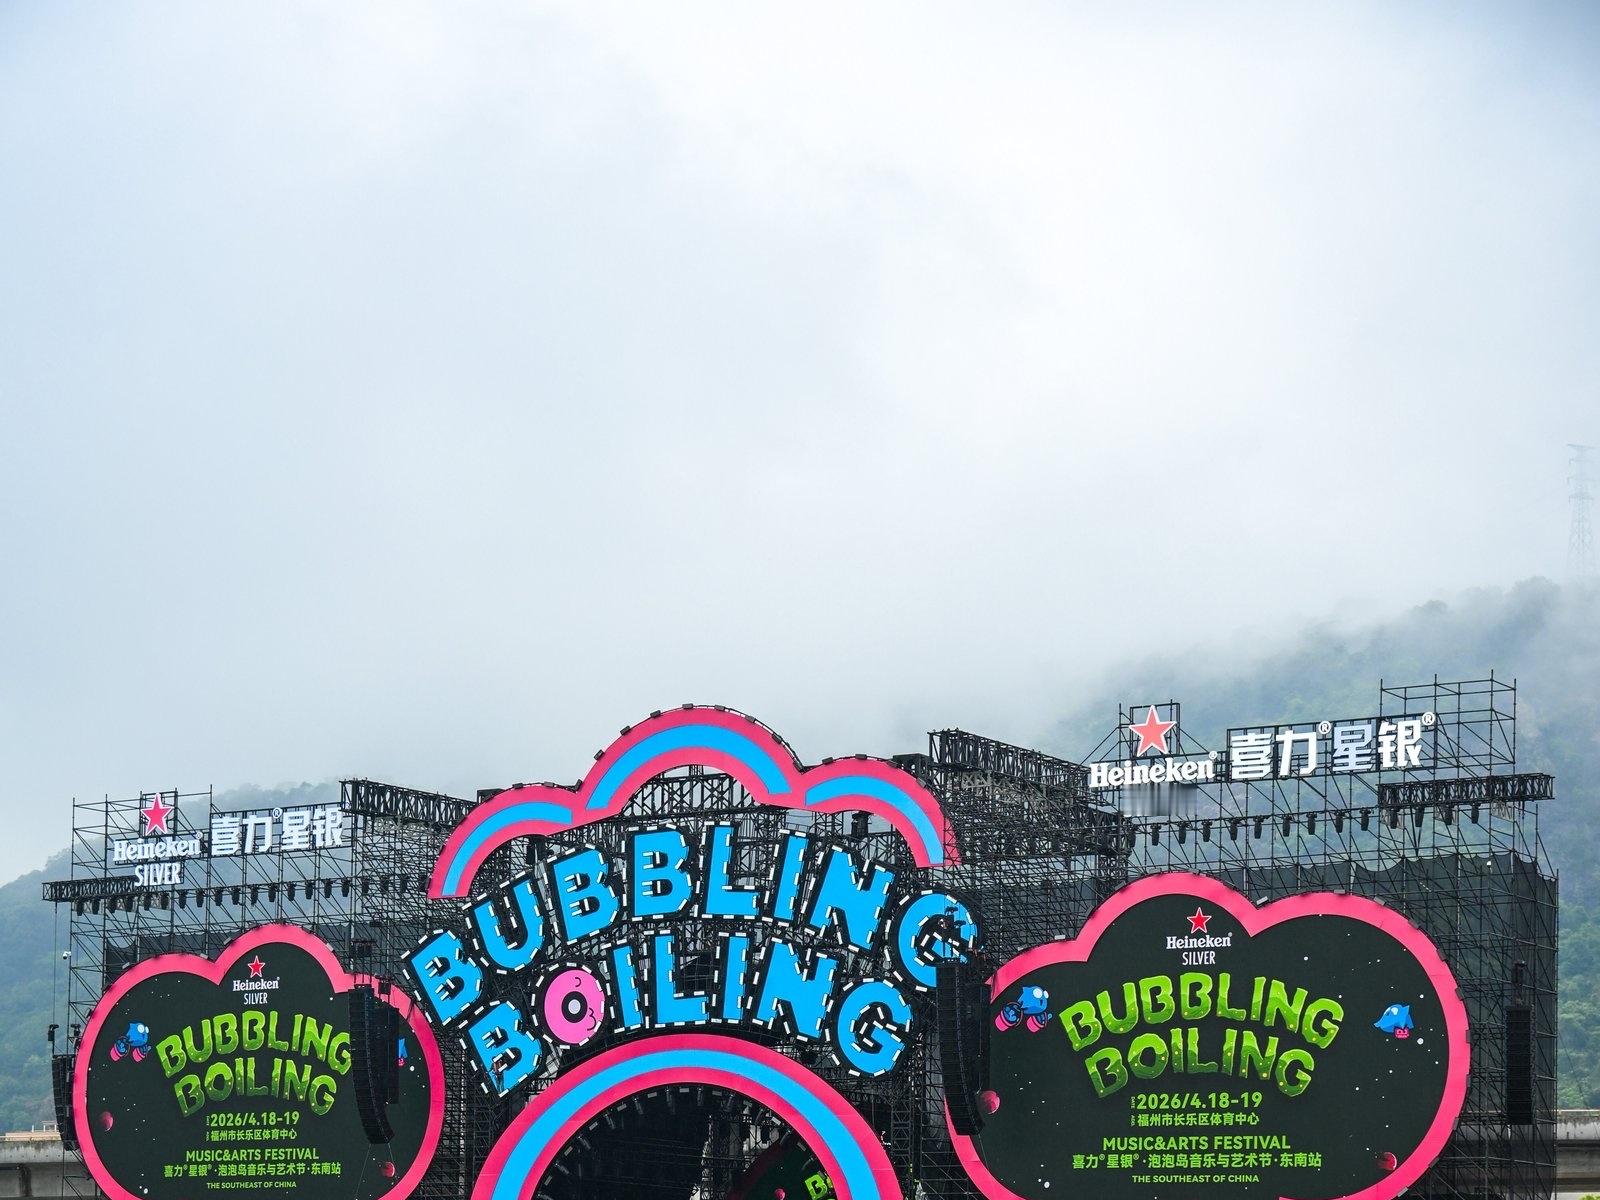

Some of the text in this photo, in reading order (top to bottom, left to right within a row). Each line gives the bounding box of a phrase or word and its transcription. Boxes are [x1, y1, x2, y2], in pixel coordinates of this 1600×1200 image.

[134, 862, 181, 887] SILVER
[410, 826, 979, 1025] BUBBLING
[1182, 950, 1216, 966] SILVER
[243, 992, 268, 1005] SILVER
[468, 931, 913, 1093] BOILING
[1059, 972, 1344, 1050] BUBBLING
[155, 1010, 352, 1078] BUBBLING
[1085, 1027, 1316, 1097] BOILING
[174, 1057, 337, 1116] BOILING
[1136, 1091, 1263, 1110] 2026/4.18-19
[210, 1110, 300, 1127] 2026/4.18-19
[1137, 1111, 1260, 1127] 福州市长乐区体育中心
[210, 1128, 298, 1142] 福州市长乐区体育中心
[1103, 1135, 1291, 1151] MUSIC&ARTS FESTIVAL
[185, 1147, 320, 1162] MUSIC&ARTS FESTIVAL
[1132, 1174, 1259, 1183] THE SOUTHEAST OF CHINA
